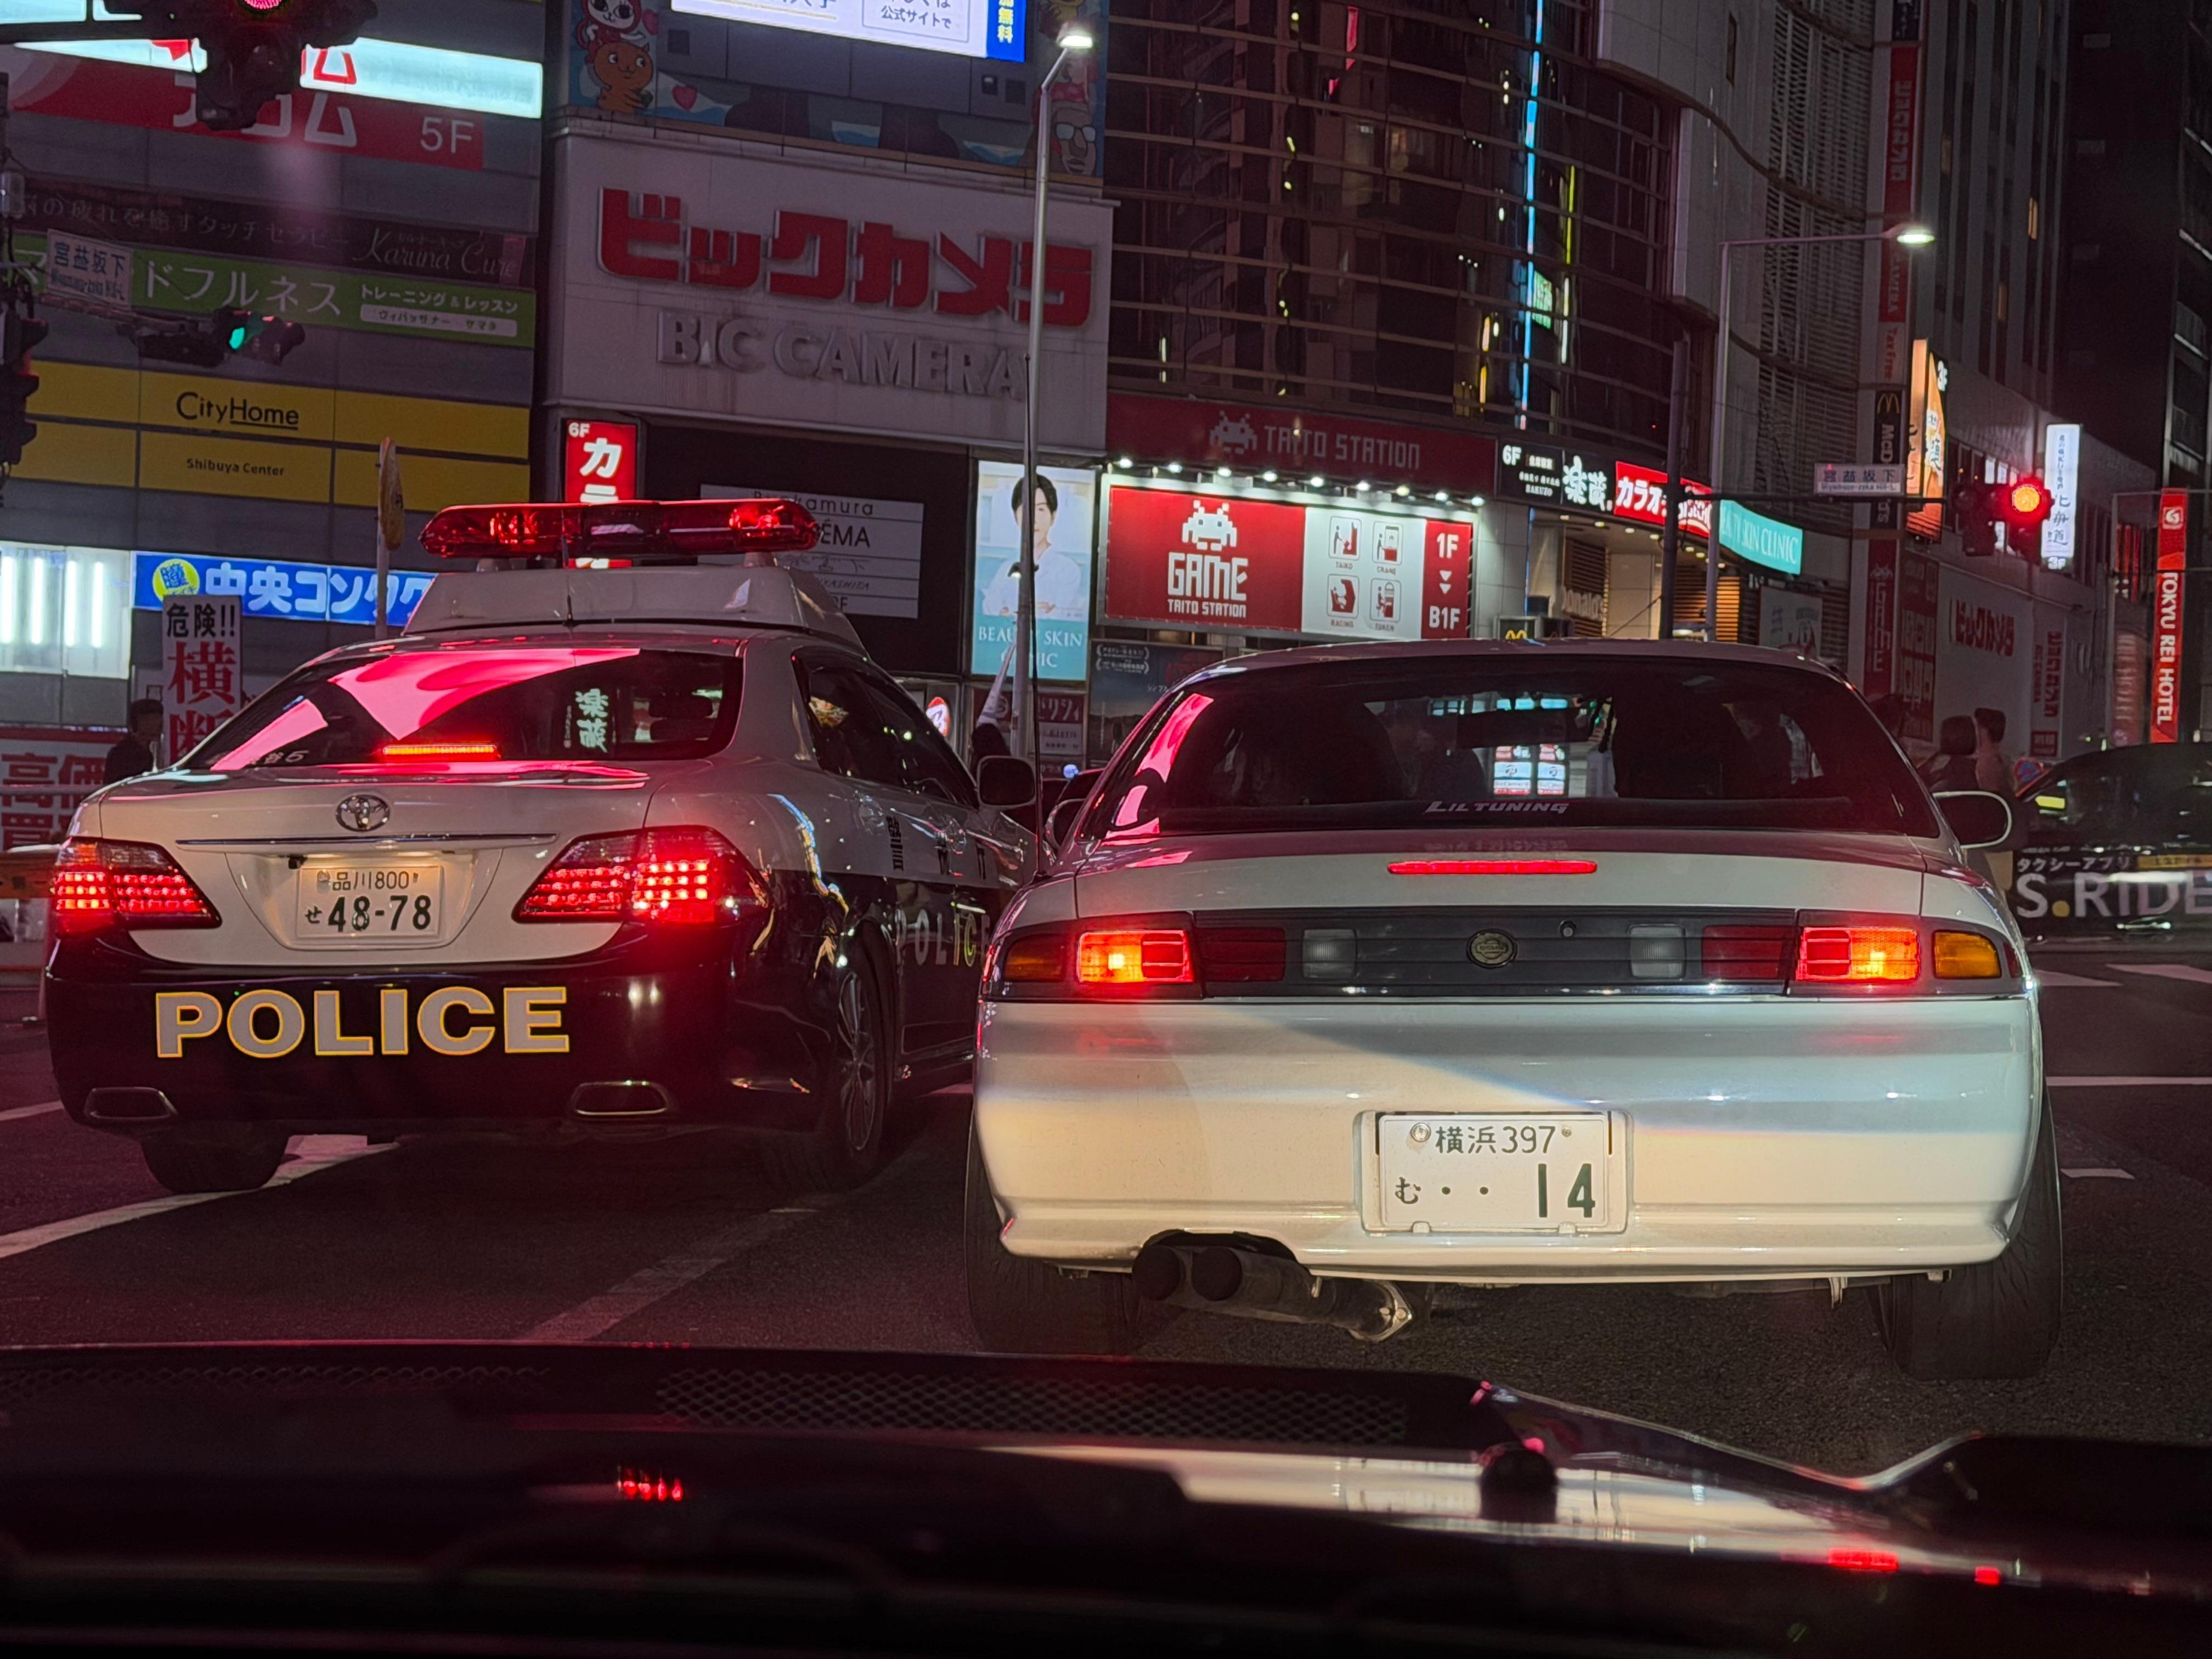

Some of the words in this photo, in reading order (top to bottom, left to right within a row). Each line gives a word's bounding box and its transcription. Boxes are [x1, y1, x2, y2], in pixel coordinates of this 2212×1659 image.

[881, 5, 952, 29] 公式サイトで
[420, 116, 475, 155] 5F
[600, 185, 1093, 328] ビックカメラ
[657, 310, 764, 374] BIC
[774, 329, 1027, 399] CAMERA
[176, 391, 299, 431] CityHome
[568, 422, 590, 438] 6F
[1264, 425, 1327, 459] TAITO
[1335, 433, 1420, 470] STATION
[187, 458, 239, 474] Shibuya
[243, 463, 285, 476] Center
[1502, 444, 1522, 466] 6F
[1436, 533, 1459, 560] 1F
[1760, 527, 1799, 565] CLINIC
[2047, 556, 2066, 570] 3F
[1168, 551, 1249, 602] GAME
[1167, 599, 1199, 614] TAITO
[1201, 601, 1246, 618] STATION
[1429, 606, 1461, 630] B1F
[2160, 572, 2179, 630] TOKYU
[166, 603, 235, 637] 危険!!
[1044, 630, 1083, 647] SKIN
[2159, 634, 2176, 663] REI
[2156, 669, 2175, 725] HOTEL
[332, 870, 410, 891] 品川800
[2016, 871, 2212, 918] S.RIDE
[304, 906, 323, 924] せ
[328, 894, 432, 932] 48-78
[155, 986, 570, 1058] POLICE
[1435, 1125, 1556, 1154] 横浜397
[1395, 1177, 1421, 1205] む
[1538, 1164, 1596, 1218] 14
